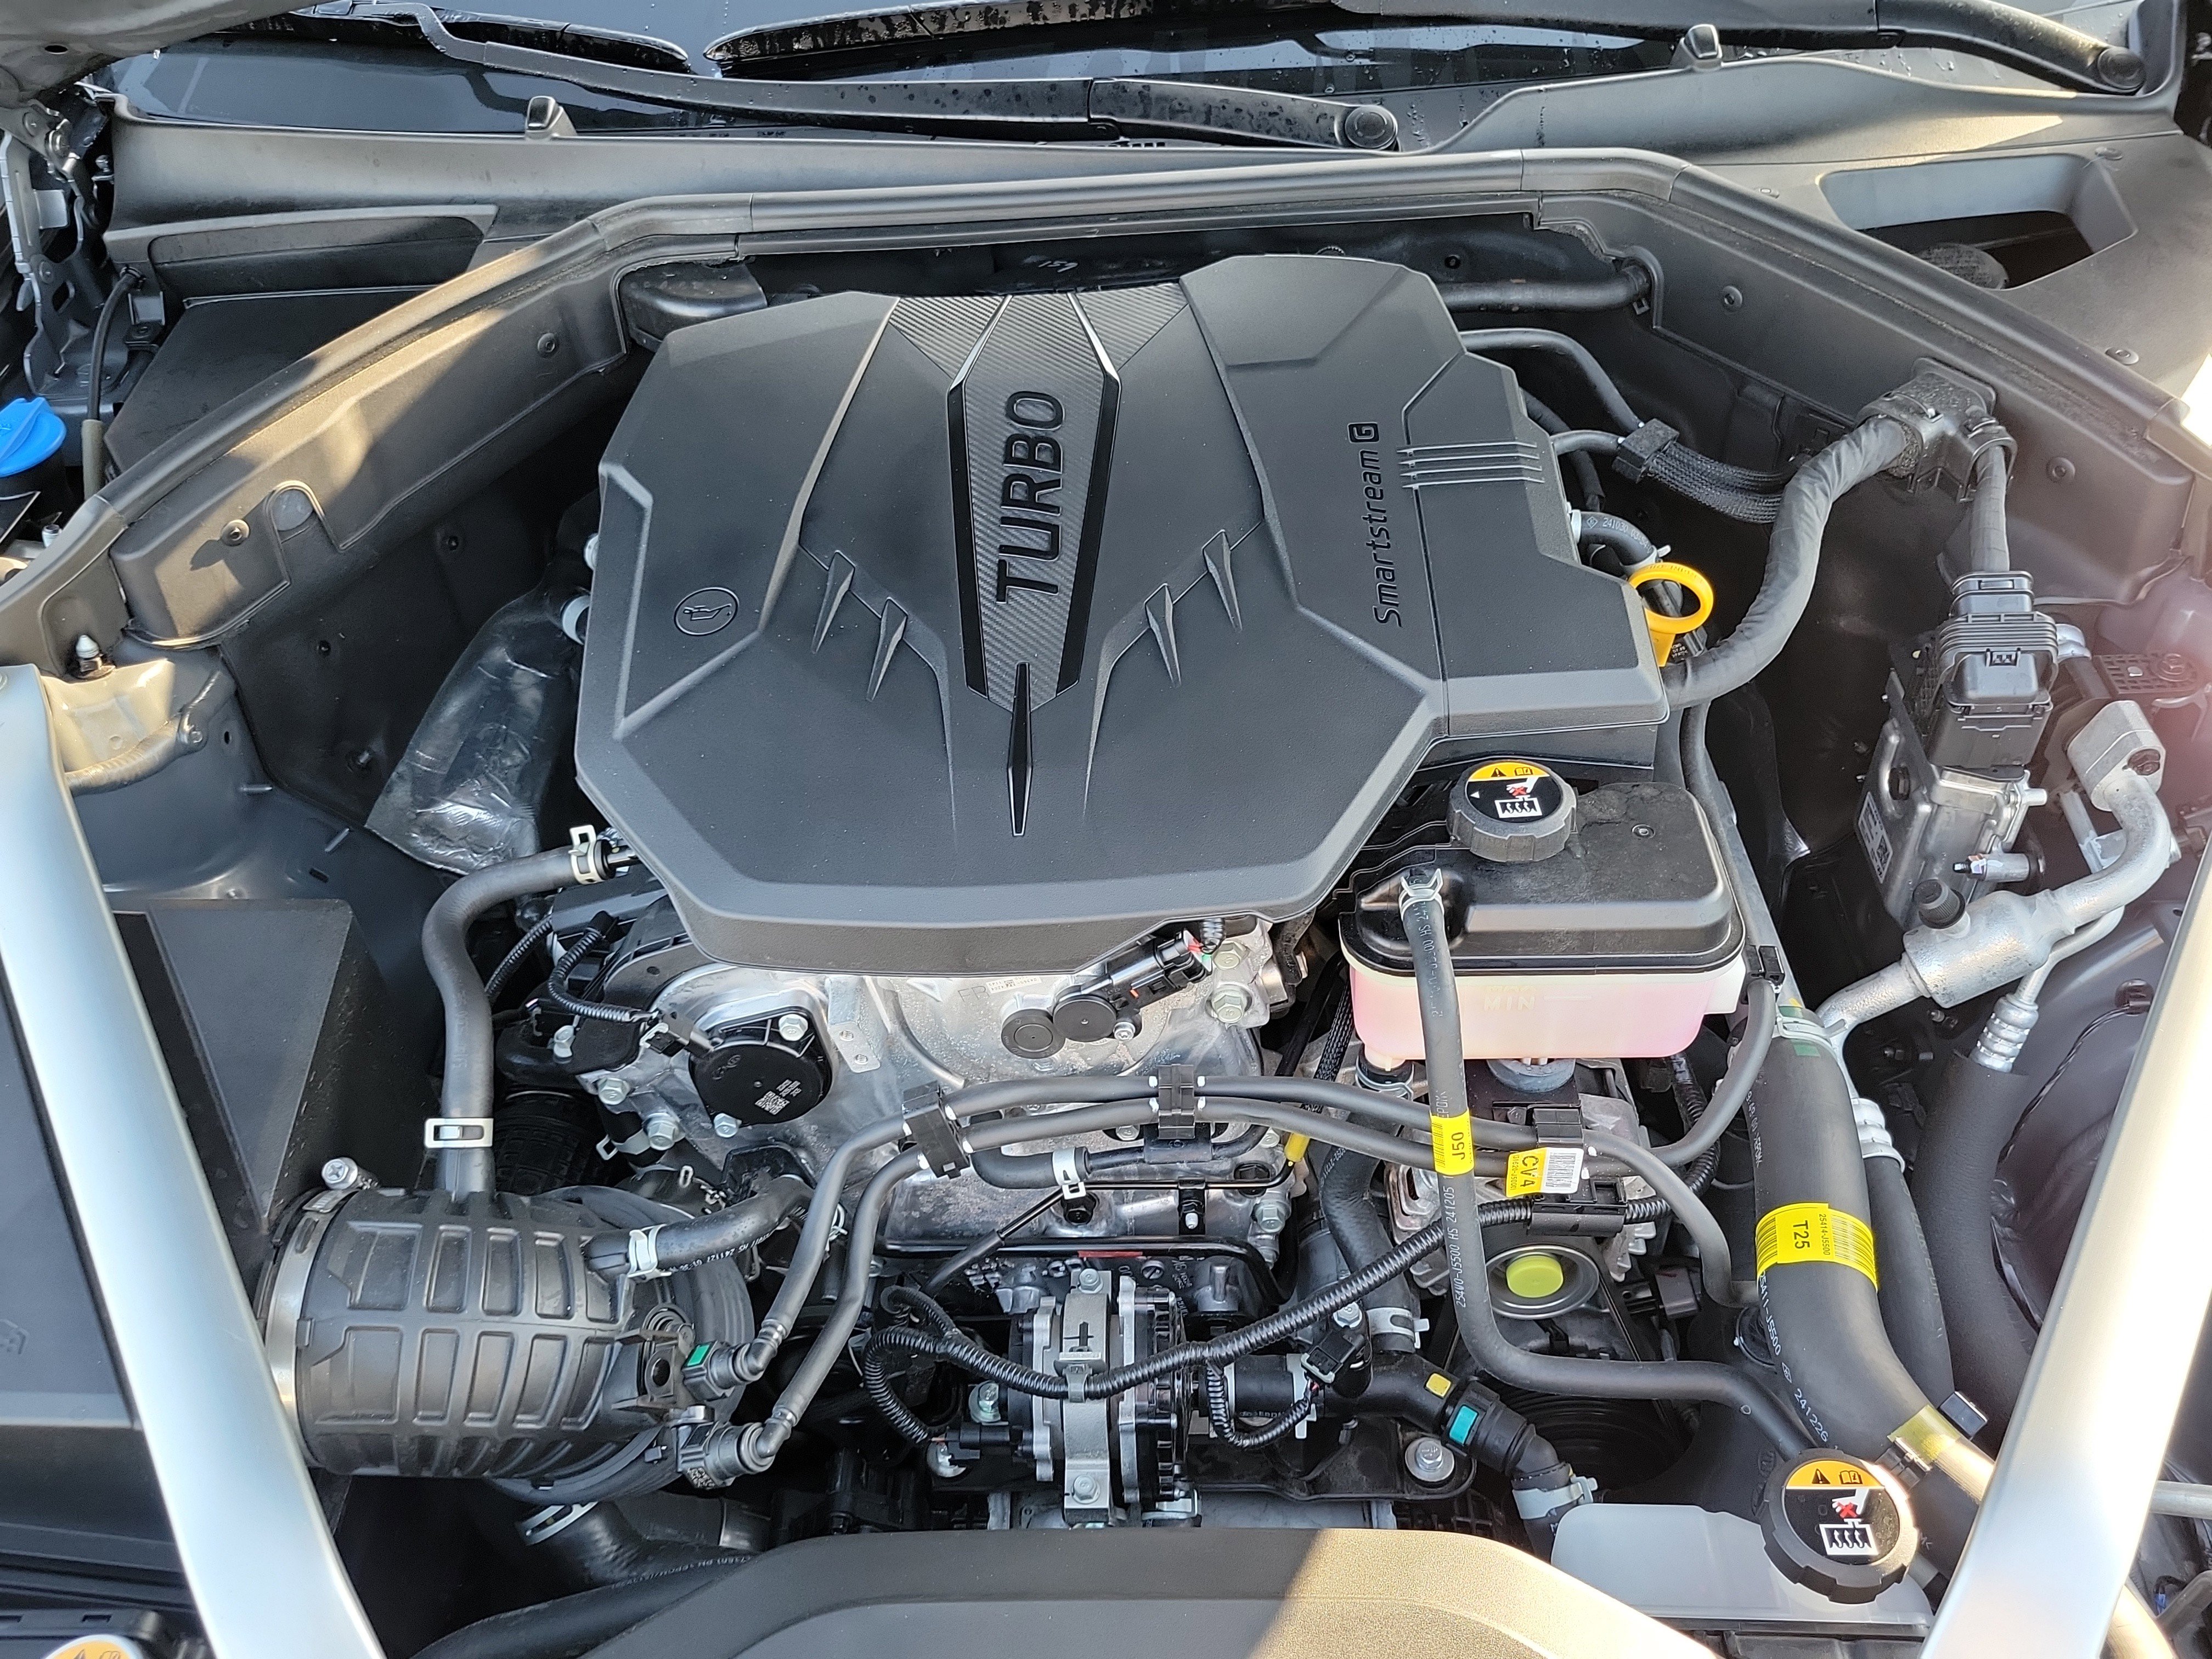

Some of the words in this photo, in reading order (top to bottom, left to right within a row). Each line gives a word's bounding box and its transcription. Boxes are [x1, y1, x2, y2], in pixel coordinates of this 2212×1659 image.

[996, 391, 1065, 603] TURBO
[1359, 449, 1402, 628] Smartstream
[957, 985, 990, 1003] FR
[1483, 996, 1536, 1011] MIN
[1450, 1131, 1465, 1160] J50
[1520, 1155, 1539, 1187] CV4
[1443, 1186, 1458, 1223] 241205
[1447, 1227, 1459, 1240] HS
[1793, 1220, 1810, 1249] T25
[1819, 1214, 1831, 1255] 25414-J5500
[1759, 1271, 1781, 1356] 25411-J5500
[1793, 1388, 1829, 1442] 241226
